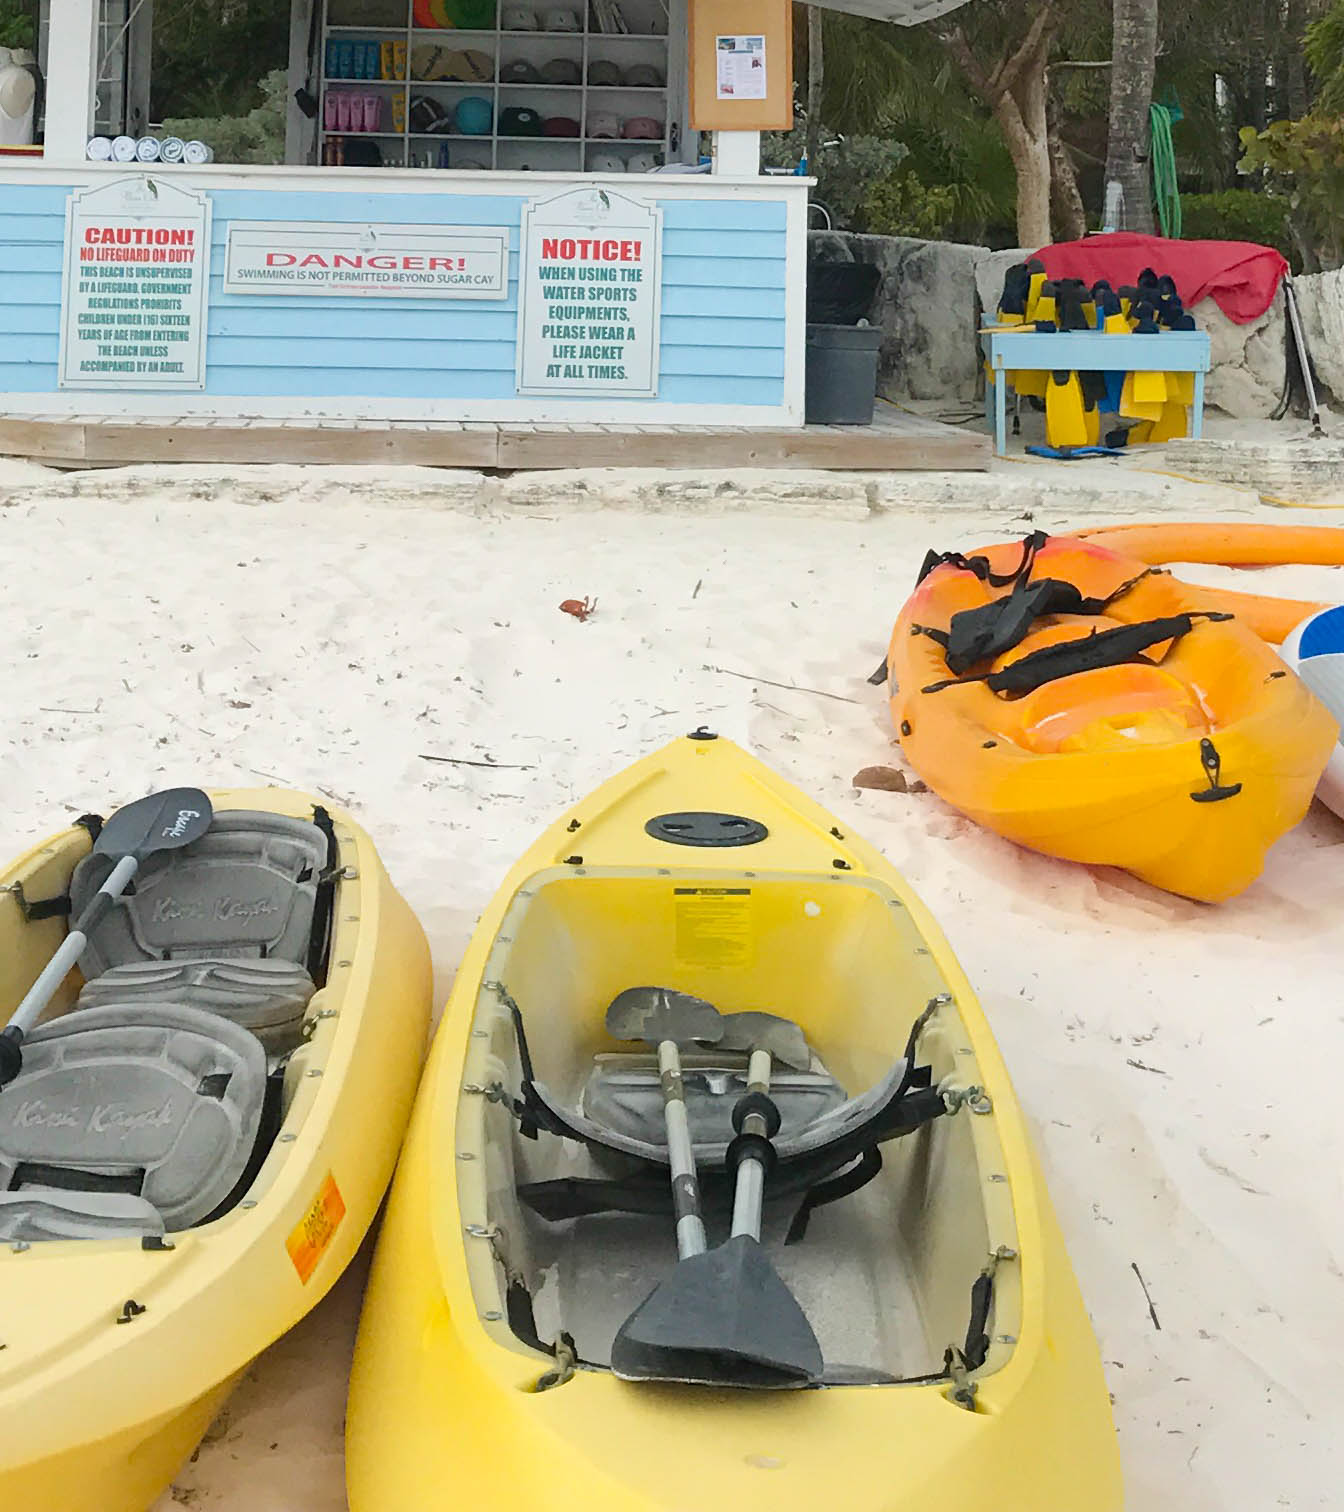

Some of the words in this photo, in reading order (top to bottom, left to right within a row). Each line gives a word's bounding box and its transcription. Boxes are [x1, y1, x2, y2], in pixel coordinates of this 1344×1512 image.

[84, 227, 195, 246] CAUTION!
[79, 246, 95, 262] NO
[96, 247, 151, 263] LIFEGUARD
[152, 248, 167, 263] ON
[168, 248, 195, 264] DUTY
[542, 238, 642, 262] NOTICE!
[266, 252, 466, 272] DANGER!
[80, 266, 98, 279] THIS
[99, 266, 124, 279] BEACH
[125, 267, 134, 279] IS
[135, 267, 193, 280] UNSUPERVISED
[237, 269, 295, 280] SWIMMING
[297, 270, 307, 280] IS
[308, 271, 331, 281] NOT
[332, 271, 391, 282] PERMITTED
[392, 273, 435, 284] BEYOND
[436, 274, 472, 285] SUGAR
[474, 275, 495, 285] CAY
[539, 266, 576, 281] WHEN
[578, 267, 617, 282] USING
[620, 268, 643, 283] THE
[79, 281, 90, 294] BY
[90, 282, 97, 294] A
[141, 283, 192, 295] GOVERNMENT
[543, 286, 586, 301] WATER
[588, 287, 638, 302] SPORTS
[88, 297, 139, 310] REGULATIONS
[141, 298, 182, 310] PROHIBITS
[78, 313, 116, 326] CHILDREN
[117, 314, 143, 326] UNDER
[160, 314, 191, 327] SIXTEEN
[548, 305, 631, 322] EQUIPMENTS,
[78, 329, 102, 342] YEARS
[103, 330, 114, 342] OF
[114, 330, 129, 342] AGE
[129, 330, 152, 342] FROM
[152, 330, 190, 342] ENTERING
[542, 325, 586, 340] PLEASE
[588, 326, 625, 341] WEAR
[626, 327, 636, 341] A
[97, 345, 112, 357] THE
[113, 345, 139, 357] BEACH
[139, 345, 169, 357] UNLESS
[552, 344, 576, 359] LIFE
[578, 345, 625, 360] JACKET
[80, 360, 136, 373] ACCOMPANIED
[136, 361, 147, 373] BY
[147, 361, 159, 373] AN
[546, 364, 561, 379] AT
[563, 364, 585, 379] ALL
[587, 365, 629, 380] TIMES.
